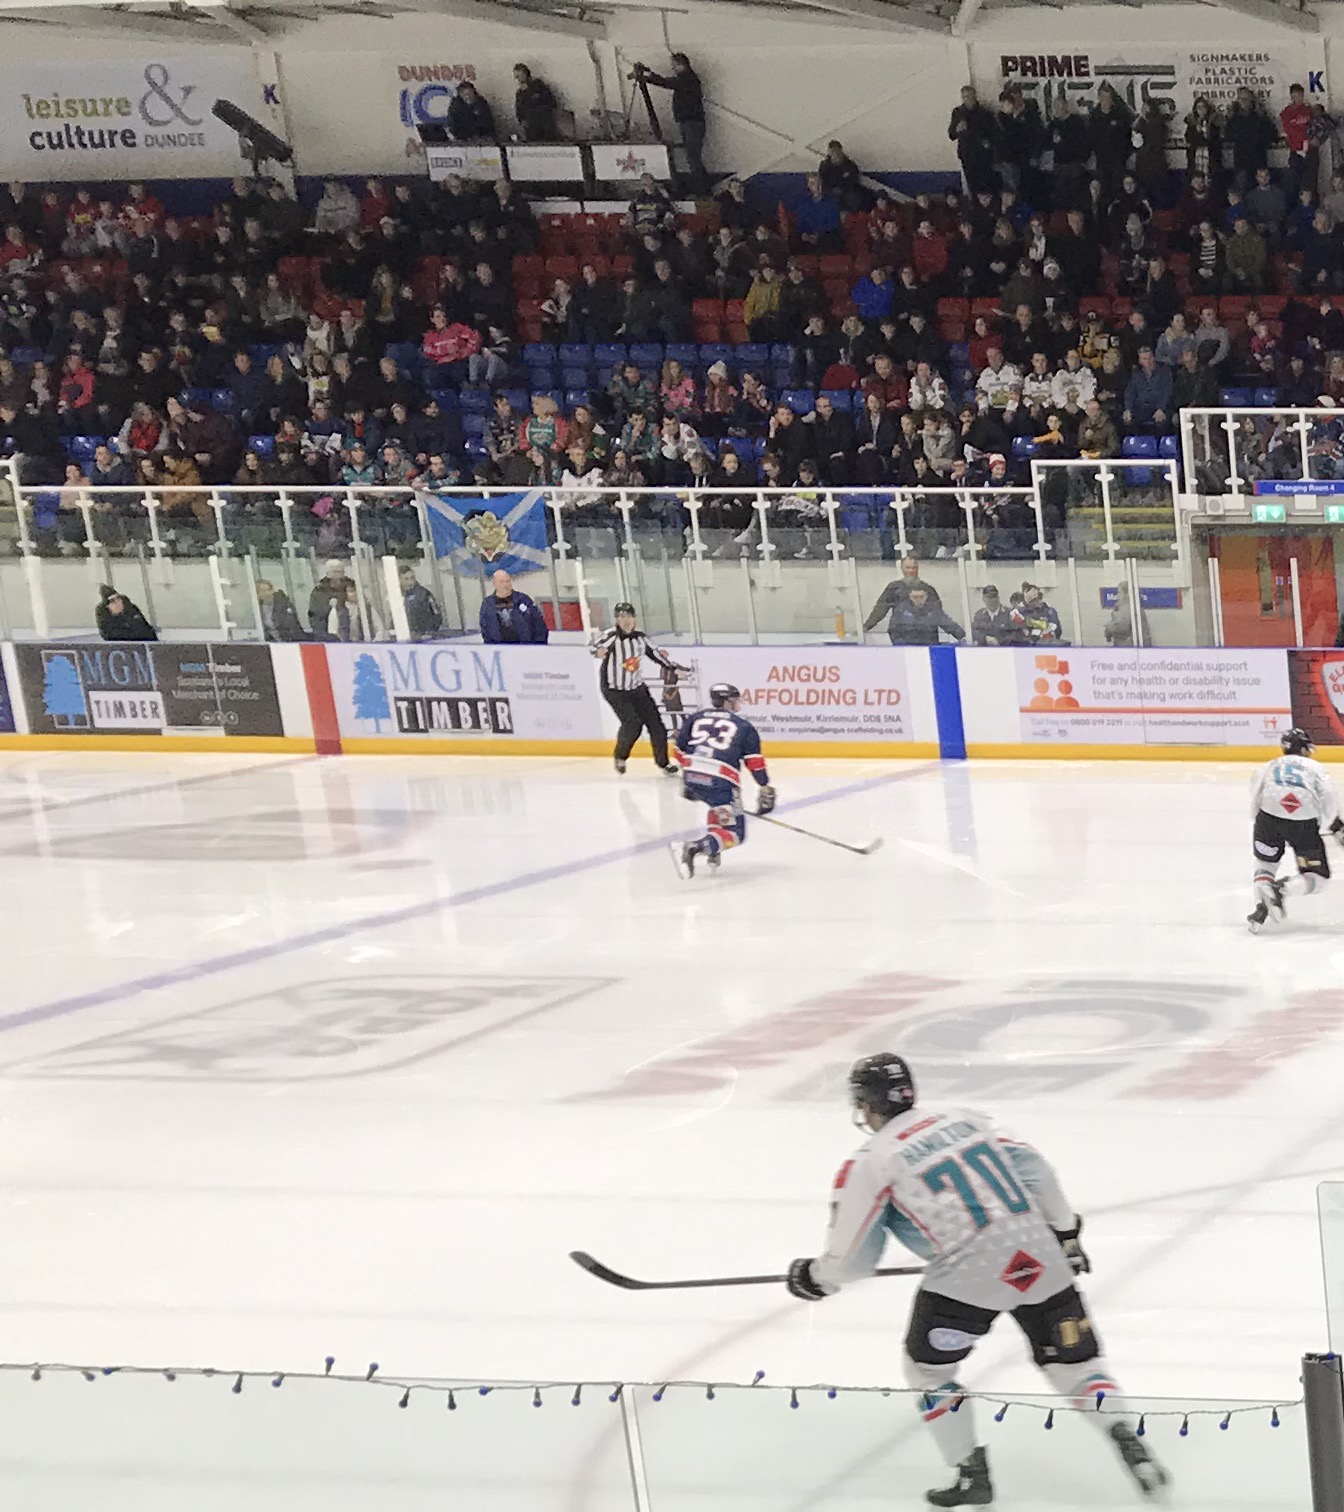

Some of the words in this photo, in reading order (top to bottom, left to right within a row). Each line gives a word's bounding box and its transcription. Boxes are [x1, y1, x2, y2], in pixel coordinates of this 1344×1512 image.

[1000, 54, 1090, 78] PRIME
[1189, 53, 1271, 63] SIGNMAKERS
[1188, 75, 1275, 86] FABRICATORS
[1204, 66, 1258, 76] PLASTIC
[1309, 71, 1325, 93] K
[22, 92, 132, 119] leisure
[138, 63, 202, 127] &
[263, 83, 280, 104] K
[29, 123, 137, 151] culture
[144, 132, 205, 148] DUNDEE
[82, 650, 159, 686] MGM
[388, 650, 507, 693] MGM
[766, 665, 841, 683] ANGUS
[1090, 660, 1115, 672] Free
[1116, 660, 1138, 672] and
[1140, 659, 1204, 672] confidential
[1205, 660, 1249, 674] support
[1092, 675, 1108, 686] for
[1109, 677, 1129, 689] any
[1131, 675, 1167, 687] health
[1168, 677, 1180, 687] or
[1182, 675, 1230, 690] disability
[1232, 676, 1261, 687] issue
[741, 688, 857, 707] AFFOLDING
[863, 688, 902, 706] LTD
[1093, 689, 1124, 701] that's
[1125, 689, 1167, 703] making
[1168, 690, 1195, 701] work
[1196, 689, 1238, 701] difficult
[94, 700, 160, 721] TIMBER
[396, 701, 513, 732] TIMBER
[689, 717, 739, 750] 53
[1272, 762, 1307, 790] 15
[900, 1118, 980, 1168] HAMILTON
[918, 1140, 1032, 1230] 70
